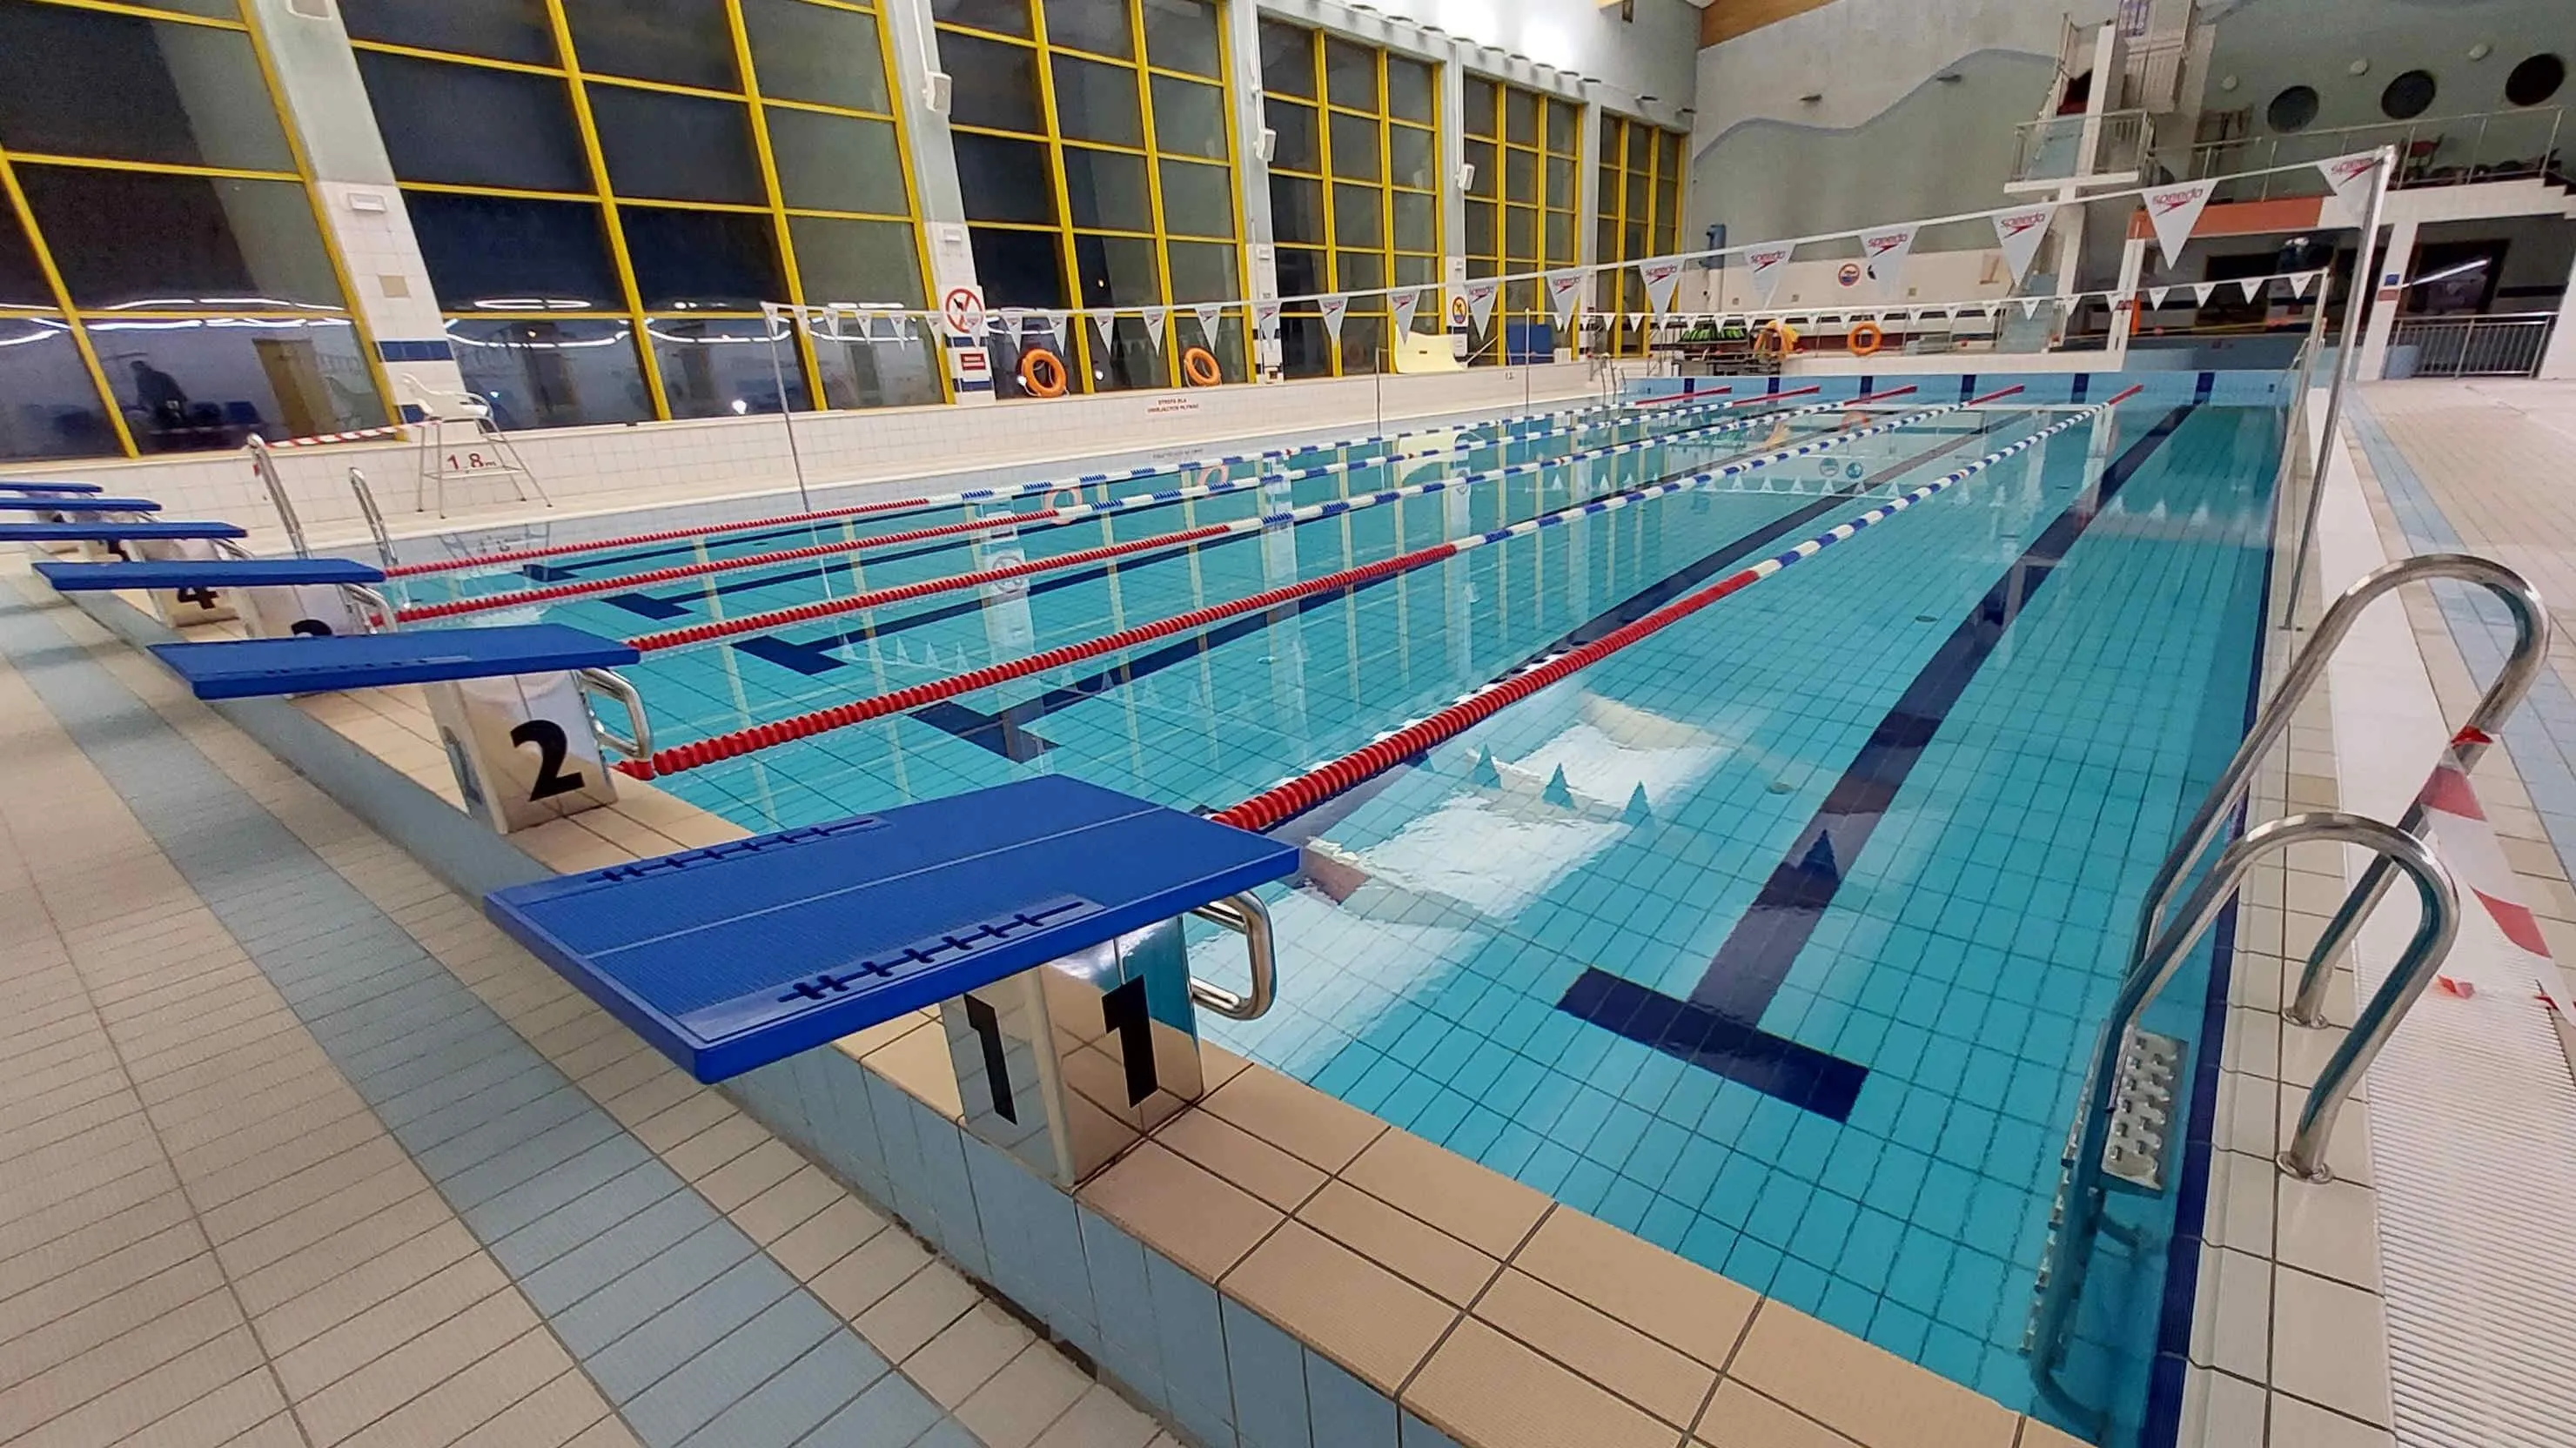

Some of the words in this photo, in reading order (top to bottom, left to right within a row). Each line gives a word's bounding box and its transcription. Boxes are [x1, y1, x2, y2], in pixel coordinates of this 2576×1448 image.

[2152, 188, 2204, 204] speedo
[2001, 213, 2045, 227] speedo
[1868, 234, 1908, 247] speedo
[1751, 251, 1786, 263] speedo
[1645, 265, 1678, 276] speedo
[510, 720, 586, 801] 2
[1101, 974, 1160, 1109] 1
[963, 993, 1018, 1125] 1
